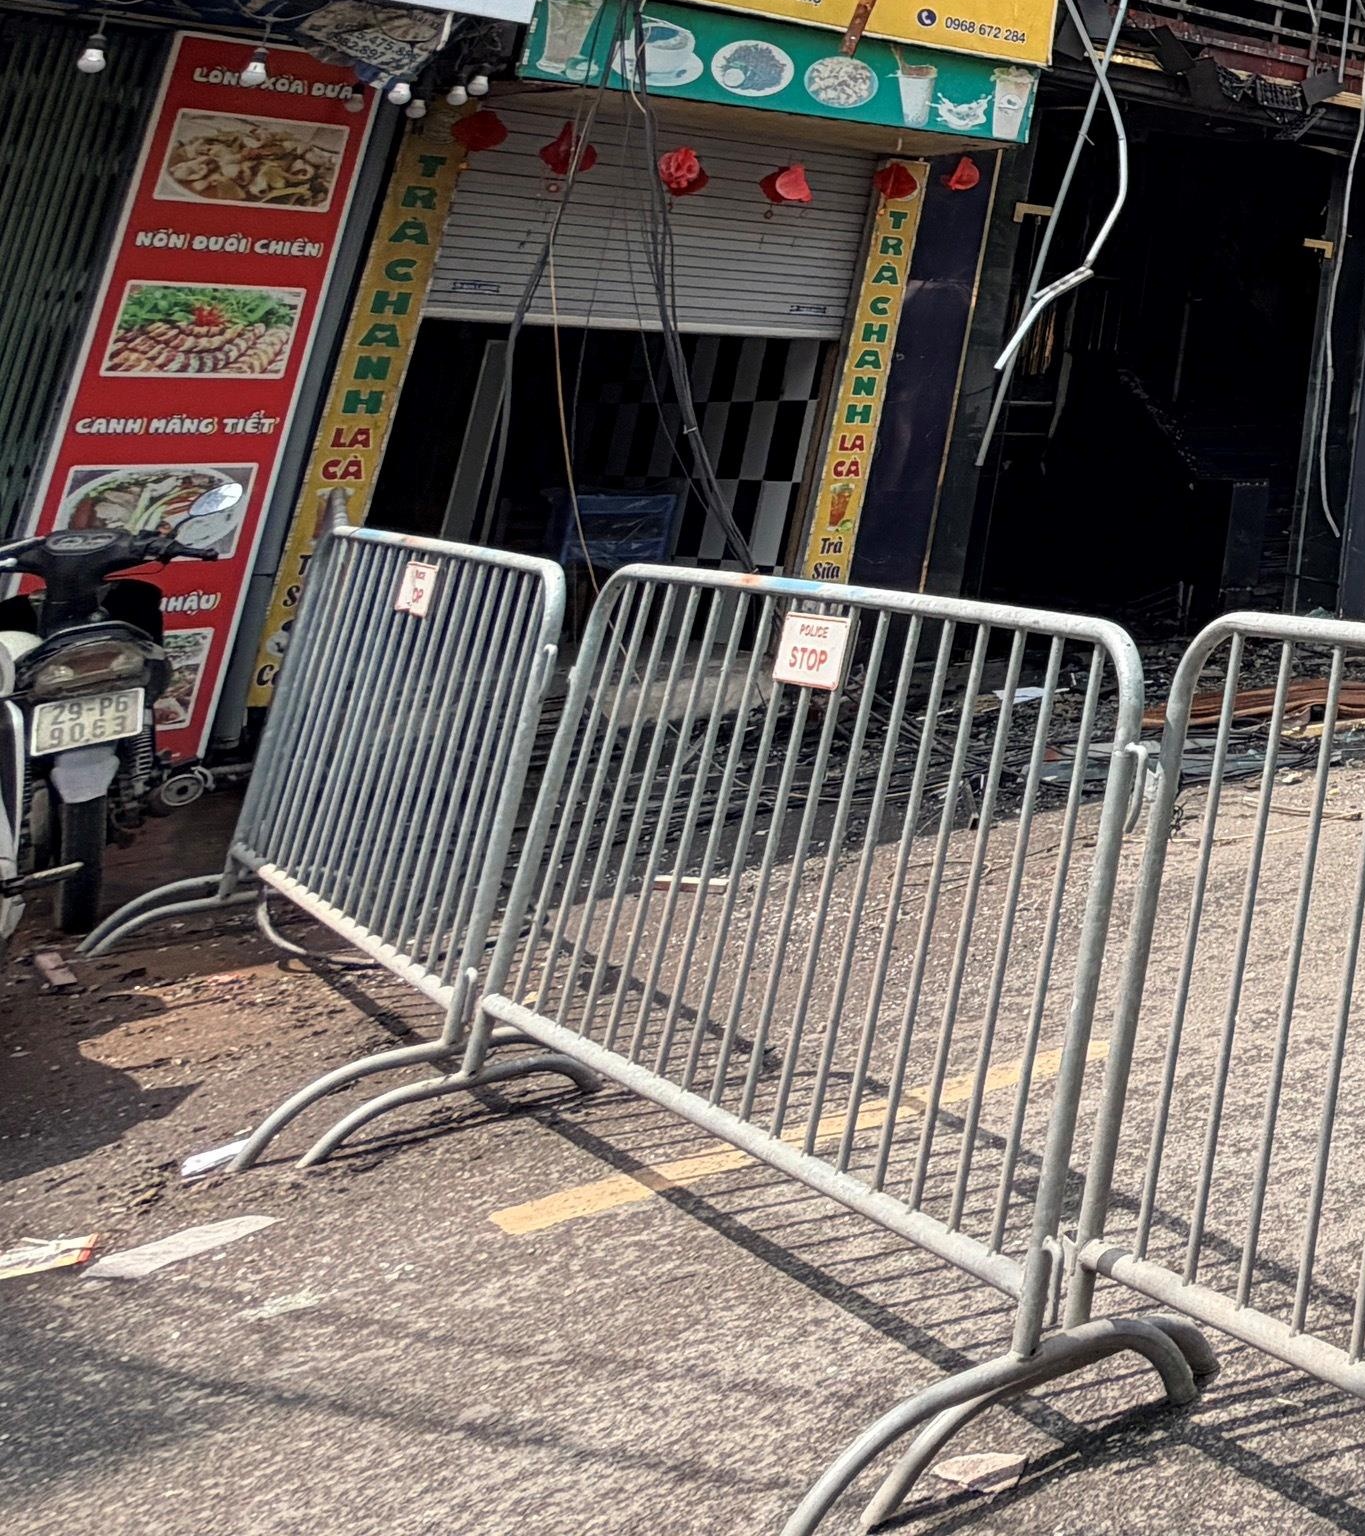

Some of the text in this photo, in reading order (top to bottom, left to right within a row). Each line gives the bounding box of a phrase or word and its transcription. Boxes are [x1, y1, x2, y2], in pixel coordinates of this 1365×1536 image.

[945, 16, 1026, 44] 0968 672 284
[75, 416, 143, 434] CANH
[330, 427, 371, 449] LA
[838, 434, 865, 452] LA
[321, 455, 363, 481] CÀ
[832, 457, 861, 478] CÀ
[821, 536, 843, 554] Trà
[812, 562, 840, 580] Sữa
[800, 623, 829, 638] POLICE
[789, 646, 828, 672] STOP
